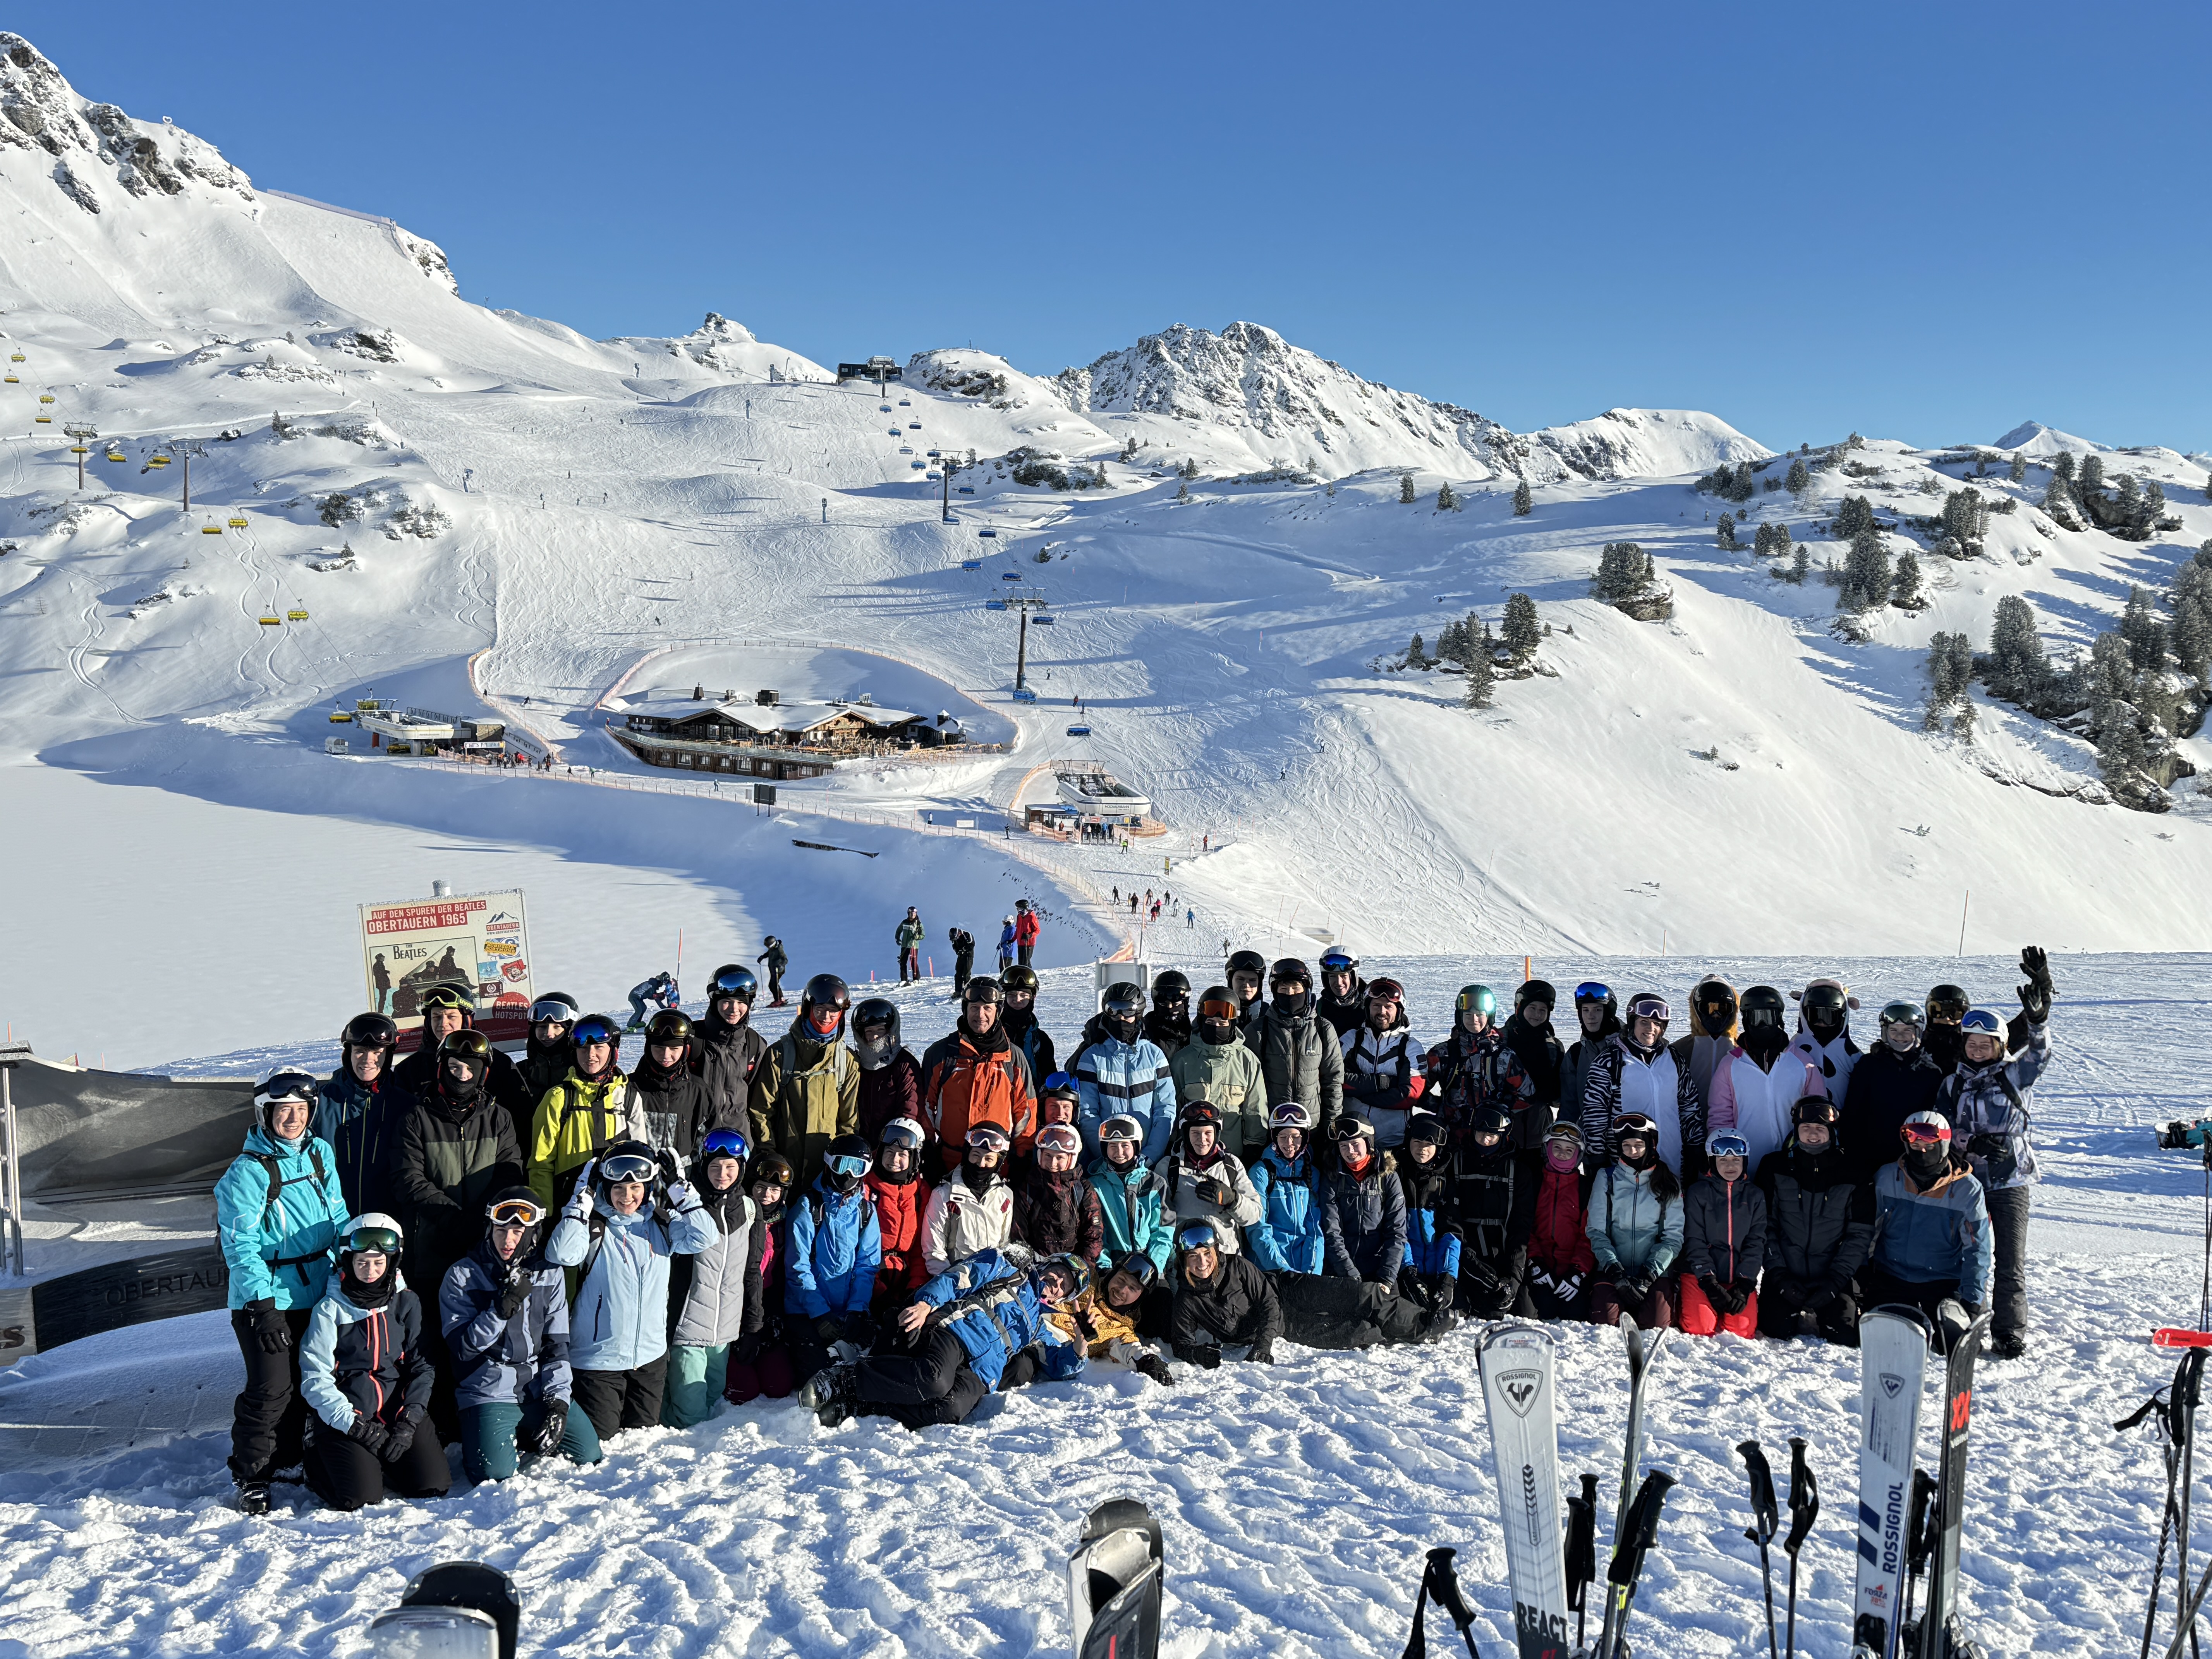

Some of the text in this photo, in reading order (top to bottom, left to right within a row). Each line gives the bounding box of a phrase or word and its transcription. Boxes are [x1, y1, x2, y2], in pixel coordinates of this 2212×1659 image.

[373, 902, 486, 920] AUF DEN SPUREN DER BEATLES
[369, 913, 465, 933] OBERTAUERN 1965
[487, 922, 519, 931] OBERTAUERN
[393, 946, 427, 960] BEATLES
[460, 998, 474, 1009] uvex
[496, 1001, 528, 1010] BEATLES
[495, 1011, 527, 1020] HOTSPOT
[1502, 1372, 1537, 1382] ROSSIGNOL
[1882, 1482, 1903, 1575] ROSSIGNOL
[1516, 1600, 1568, 1645] REACT
